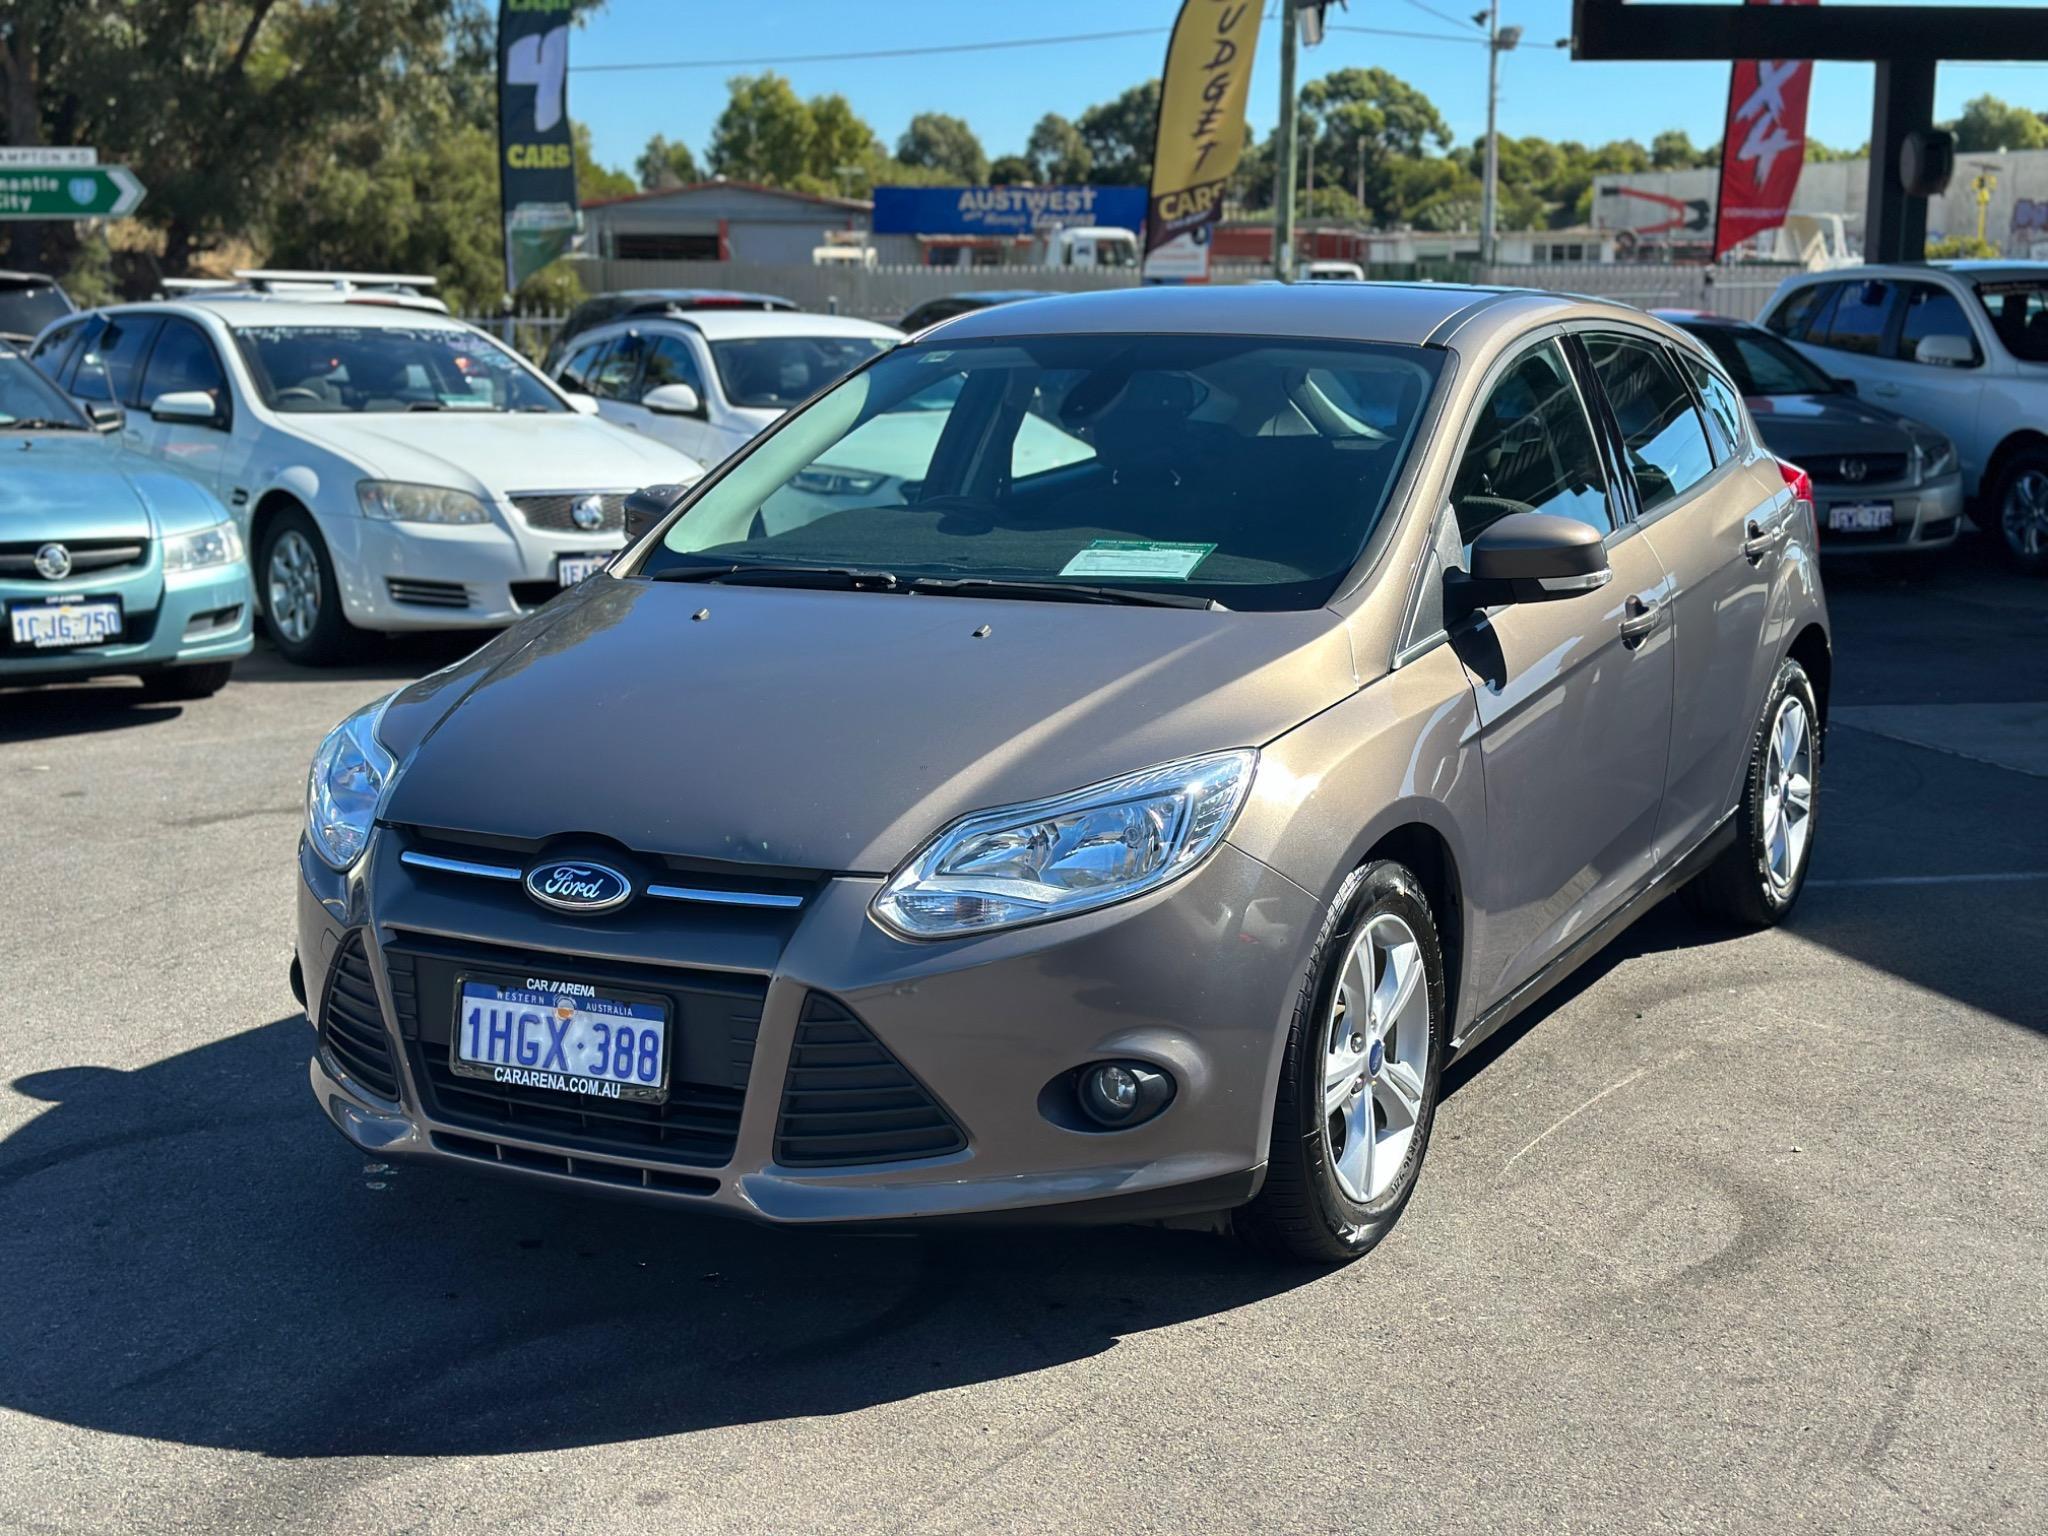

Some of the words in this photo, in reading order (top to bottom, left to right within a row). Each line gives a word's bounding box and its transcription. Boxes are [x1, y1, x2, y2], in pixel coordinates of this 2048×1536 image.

[507, 25, 569, 132] 4
[1191, 0, 1247, 172] UDGET
[1735, 60, 1800, 191] X4
[507, 144, 570, 168] CARS
[958, 186, 1098, 211] AUSTWEST
[545, 867, 604, 898] Ford
[526, 978, 548, 992] CAR
[496, 990, 545, 1005] WESTERN
[586, 1002, 633, 1017] AUSTRALIA
[494, 1066, 621, 1099] CARARENA.COM.AU
